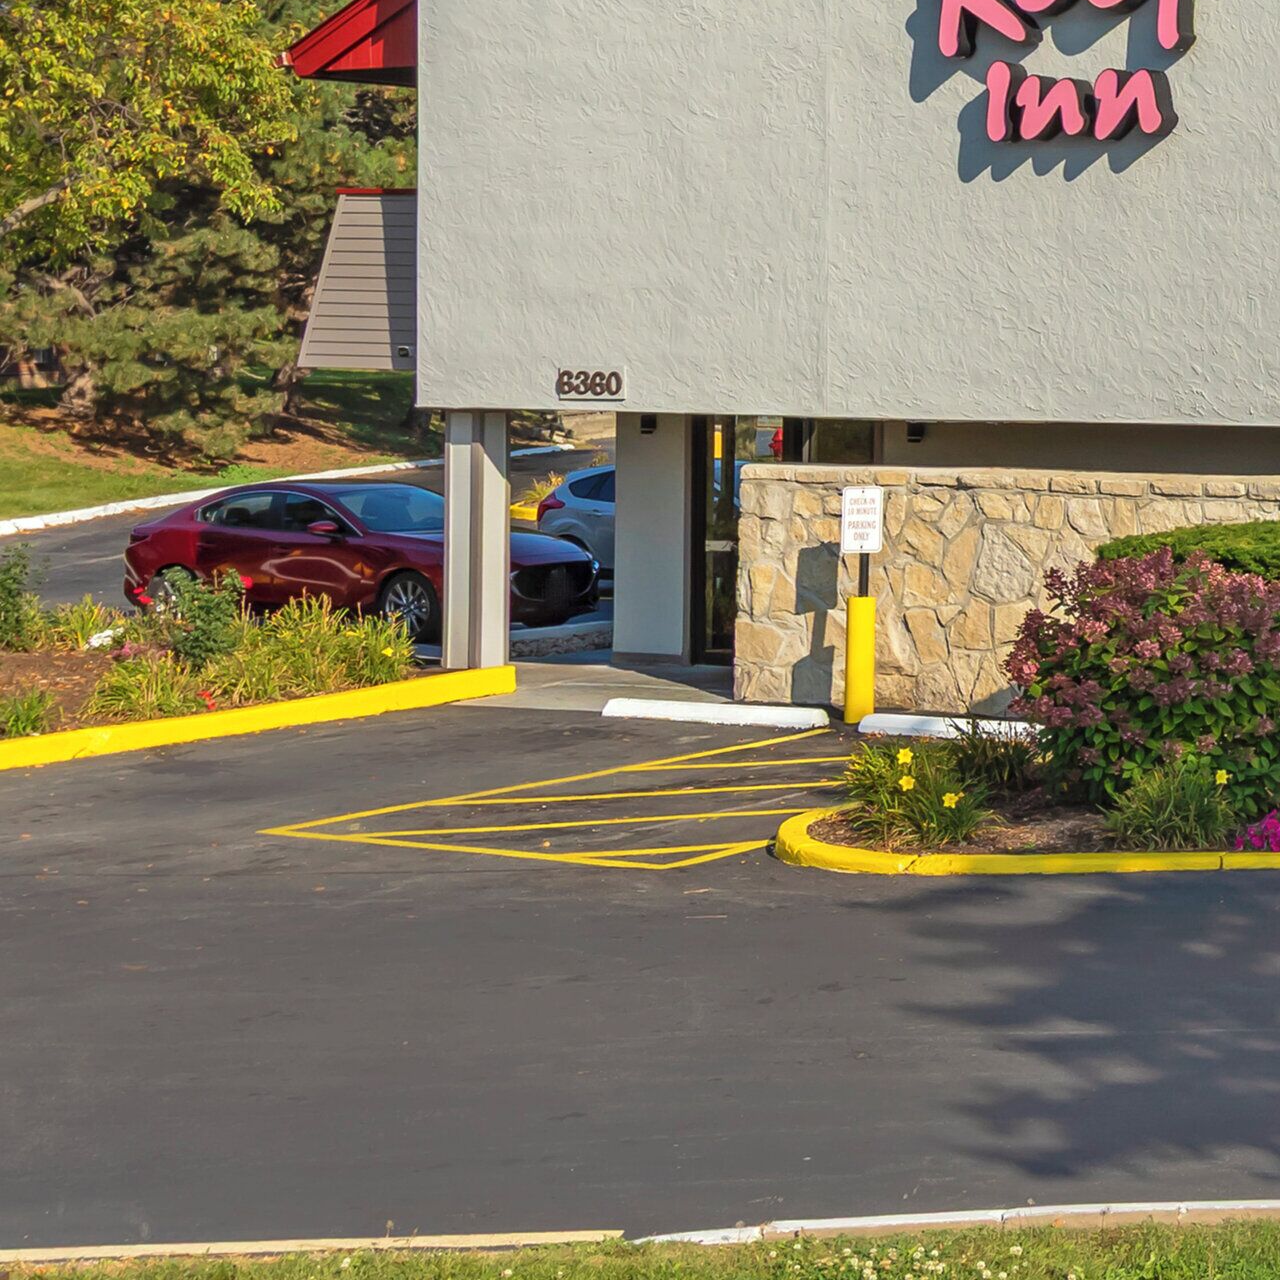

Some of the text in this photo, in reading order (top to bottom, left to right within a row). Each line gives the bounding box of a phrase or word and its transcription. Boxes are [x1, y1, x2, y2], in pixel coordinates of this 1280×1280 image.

[985, 60, 1164, 143] Inn
[557, 369, 623, 396] 6360
[857, 507, 877, 516] MINUTE
[848, 521, 877, 530] PARKING
[853, 532, 870, 541] ONLY
